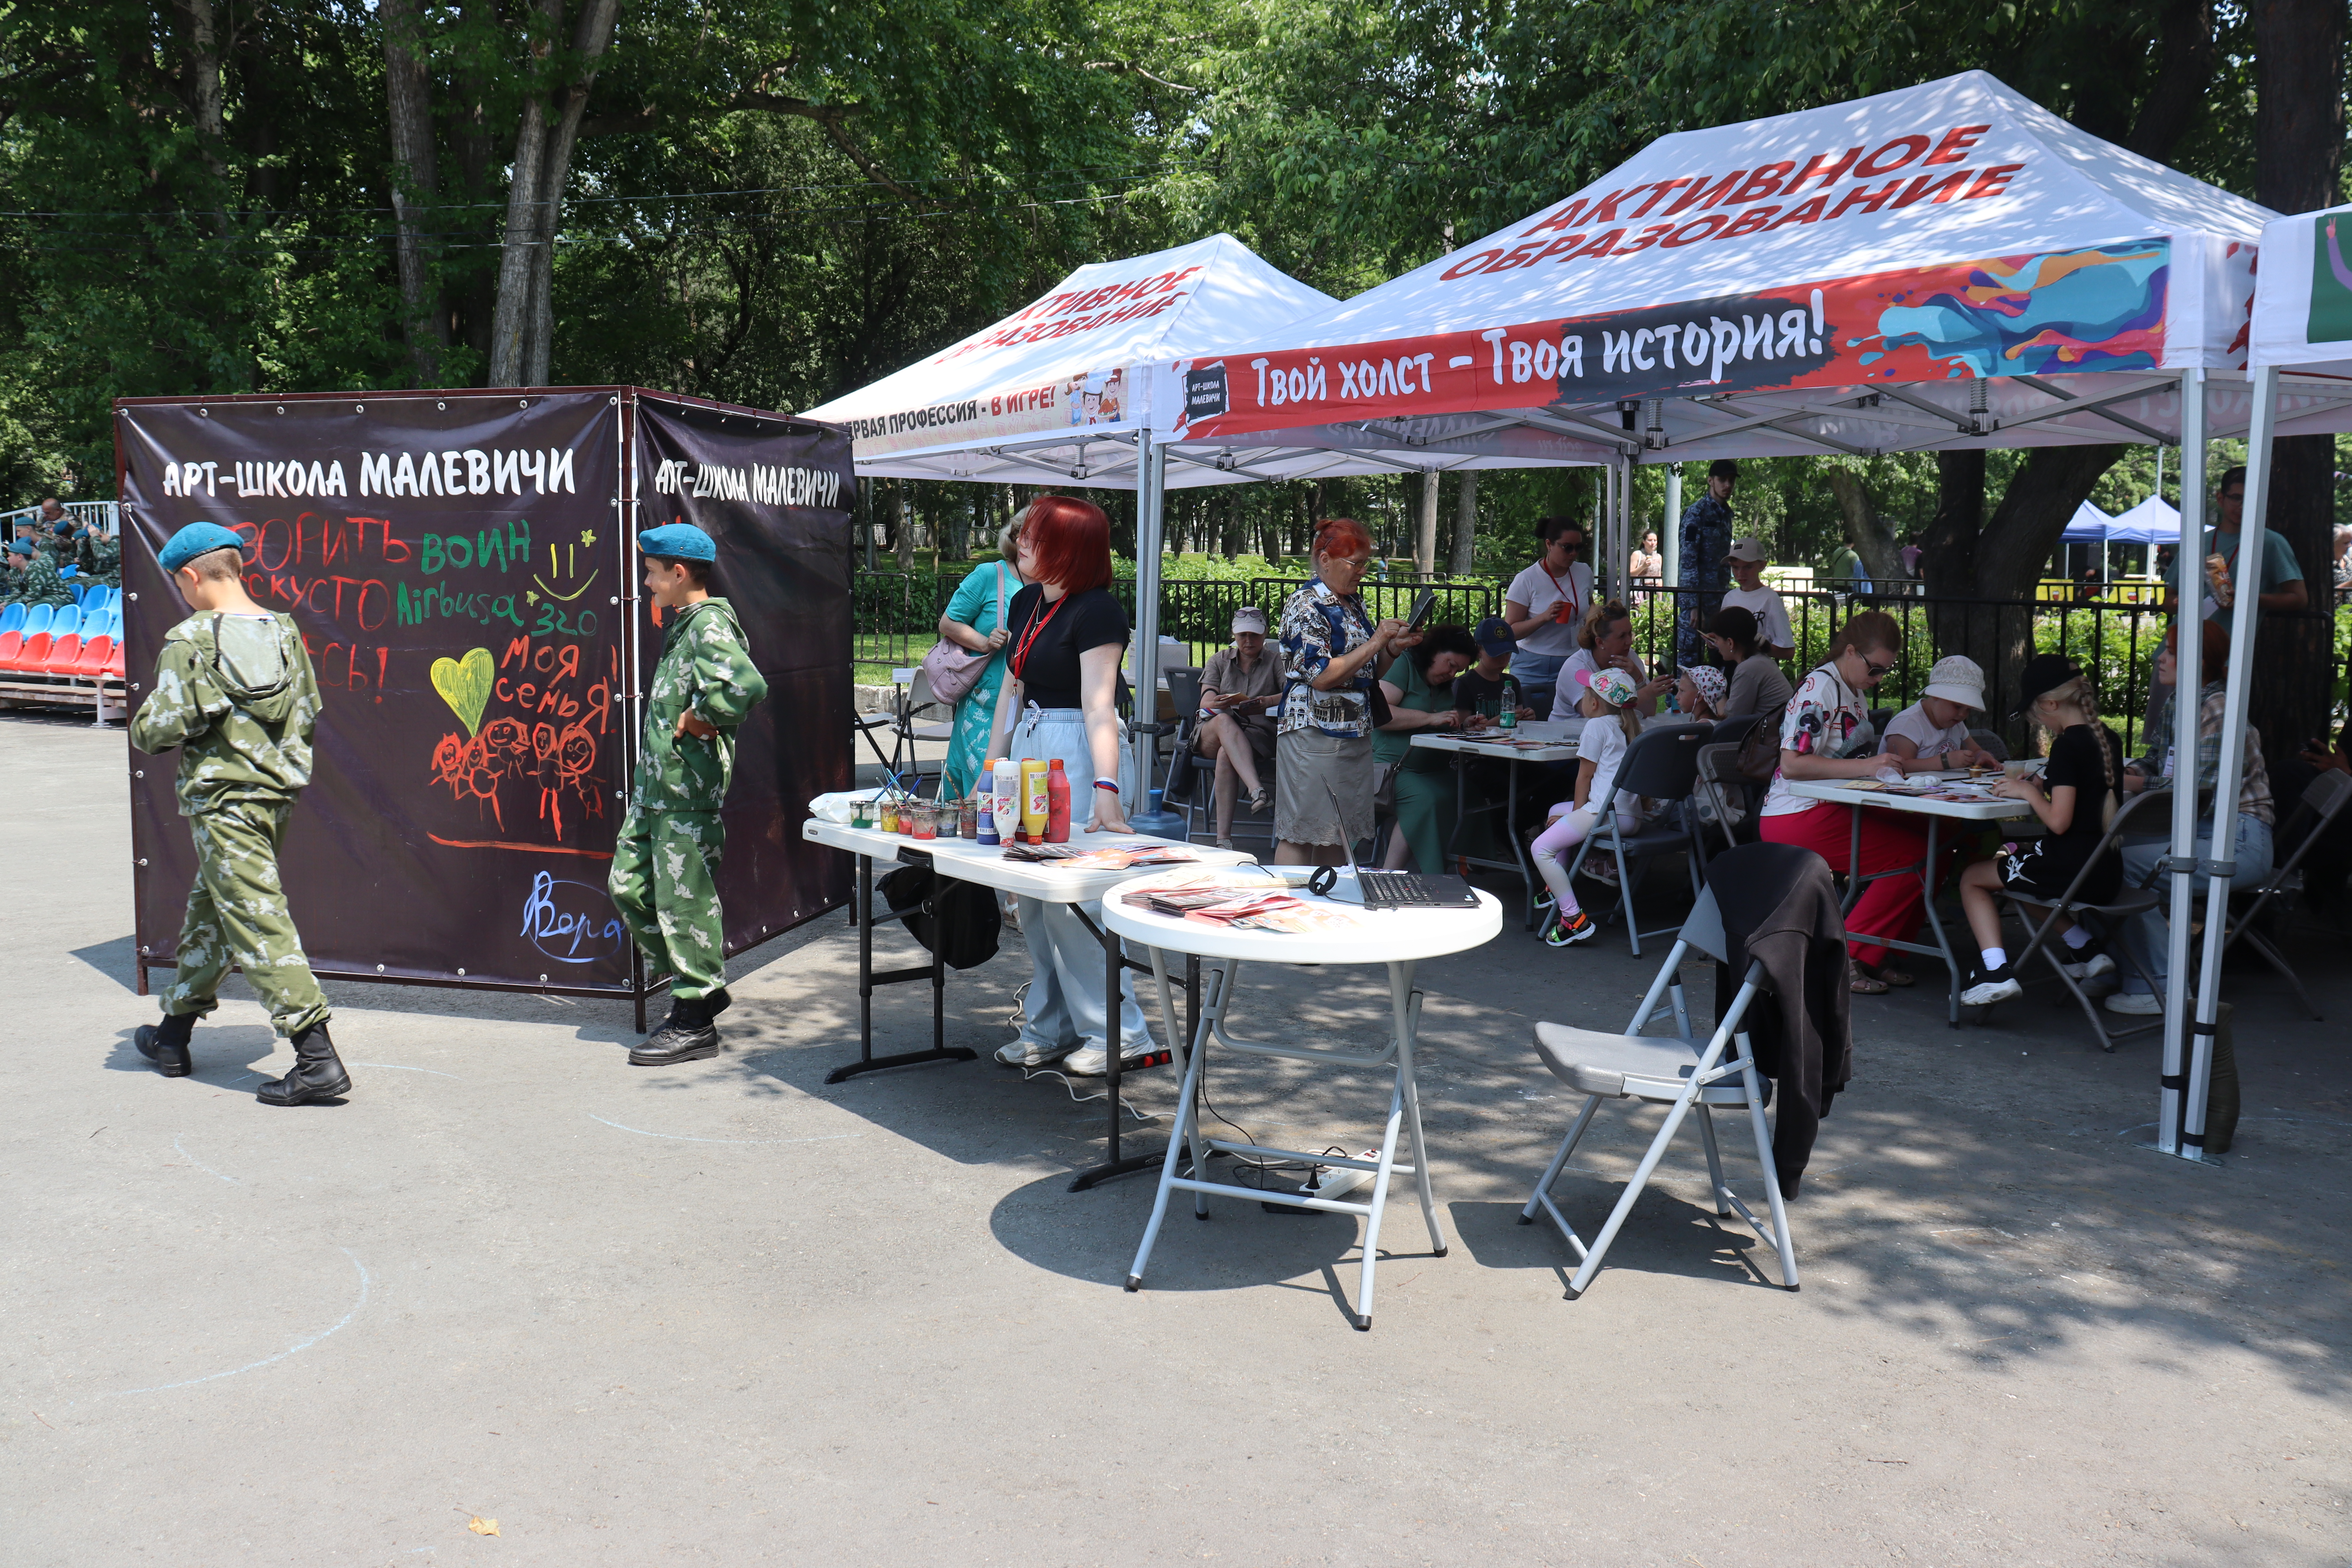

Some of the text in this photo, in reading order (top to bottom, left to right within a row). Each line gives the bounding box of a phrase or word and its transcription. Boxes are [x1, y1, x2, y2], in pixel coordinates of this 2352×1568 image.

[1517, 124, 1992, 238] АКТИВНОЕ
[1439, 163, 2026, 281] ОБРАЗОВАНИЕ
[1250, 356, 1327, 407] Твой
[1338, 352, 1435, 399] холст
[1481, 328, 1583, 385] Твоя
[1602, 288, 1825, 384] история!
[837, 416, 886, 439] РВАЯ
[889, 399, 978, 434] ПРОФЕССИЯ
[991, 396, 1002, 416] В
[1006, 385, 1057, 414] ИГРЕ!
[1191, 392, 1221, 406] МАЛЕВИЧИ
[1192, 379, 1220, 392] АРТ-ШКОЛА
[163, 447, 576, 498] АРТ-ШКОЛА МАЛЕВИЧИ
[655, 457, 840, 508] АРТ-ШКОЛА МАЛЕВИЧИ
[222, 511, 412, 571] ВОРИТЬ
[240, 573, 390, 632] СКУСТО
[531, 603, 597, 637] 320
[301, 632, 389, 704] ЕСЬ!
